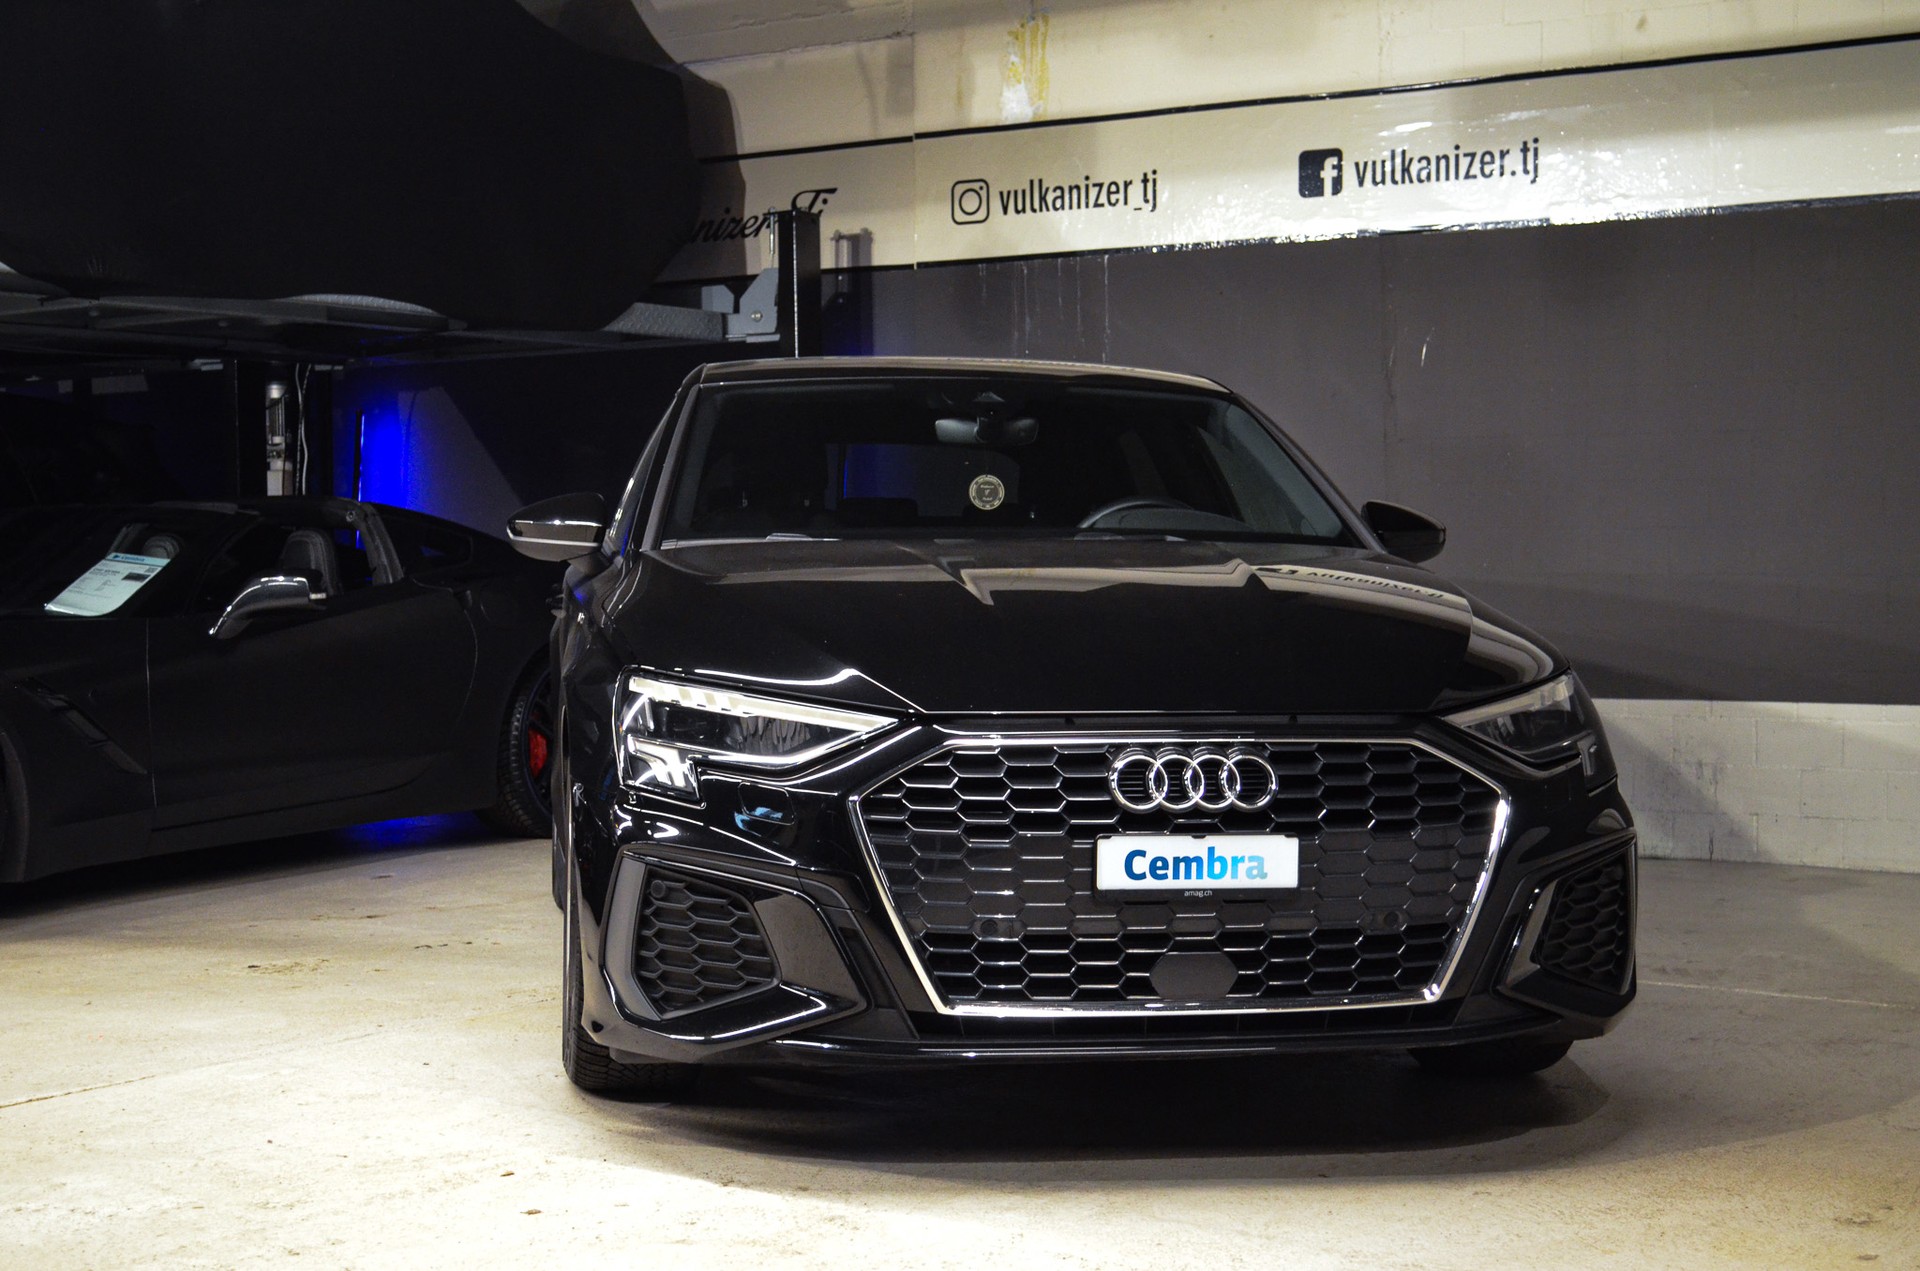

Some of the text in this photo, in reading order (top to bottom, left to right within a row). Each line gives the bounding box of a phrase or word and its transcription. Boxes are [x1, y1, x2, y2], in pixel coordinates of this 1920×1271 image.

[1354, 137, 1540, 187] vulkanizer.tj
[999, 169, 1158, 213] vulkanizer_tj
[690, 207, 779, 243] nizer
[1123, 846, 1269, 881] Cembra
[1183, 889, 1214, 898] amag.ch
